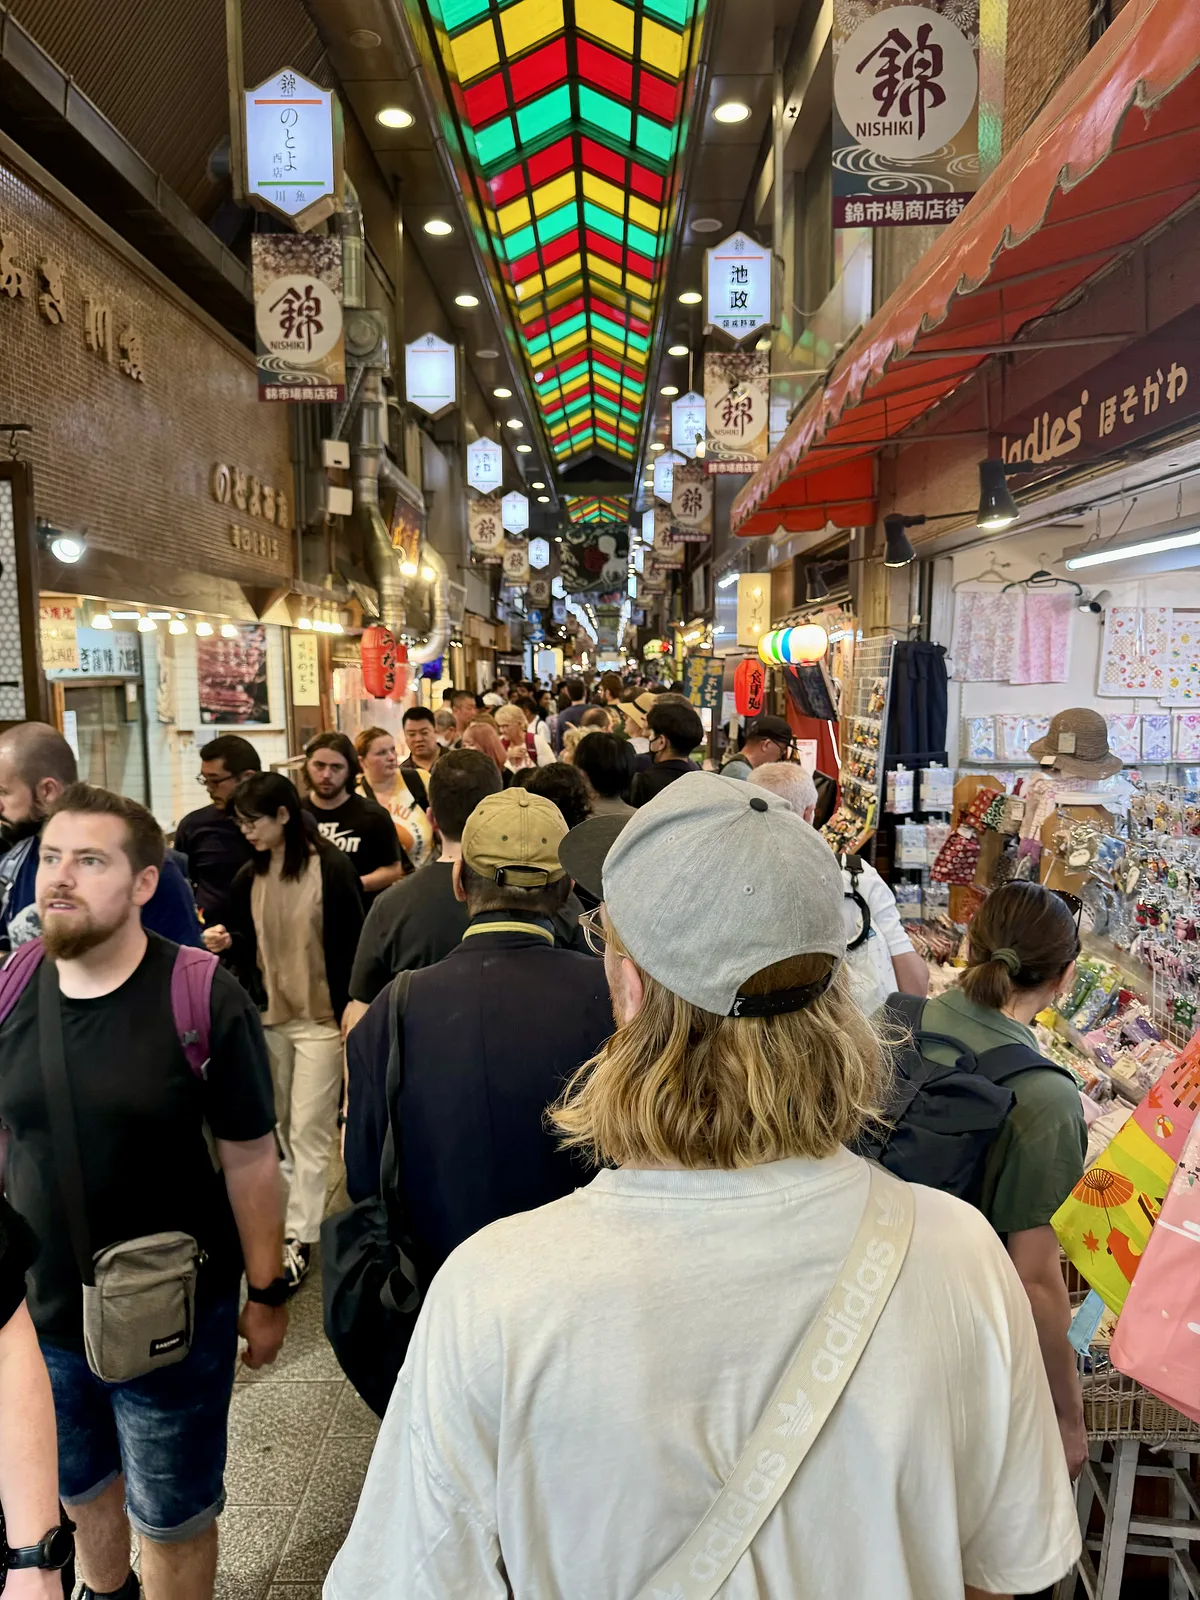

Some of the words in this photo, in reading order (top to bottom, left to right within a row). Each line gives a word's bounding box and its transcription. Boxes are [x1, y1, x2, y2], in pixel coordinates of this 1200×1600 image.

[855, 24, 946, 140] 錦
[280, 108, 298, 172] のとよ
[856, 121, 913, 137] NISHIKI
[274, 189, 307, 203] 川魚
[844, 198, 965, 222] 錦市場商店街
[731, 265, 748, 308] 池政
[269, 285, 324, 353] 錦
[270, 341, 306, 351] NISHIKI
[265, 387, 338, 400] 錦市場商店街
[1099, 362, 1188, 438] ほそかわ
[381, 633, 397, 690] うなぎ
[811, 1237, 895, 1383] adidas
[688, 1449, 788, 1583] adidas
